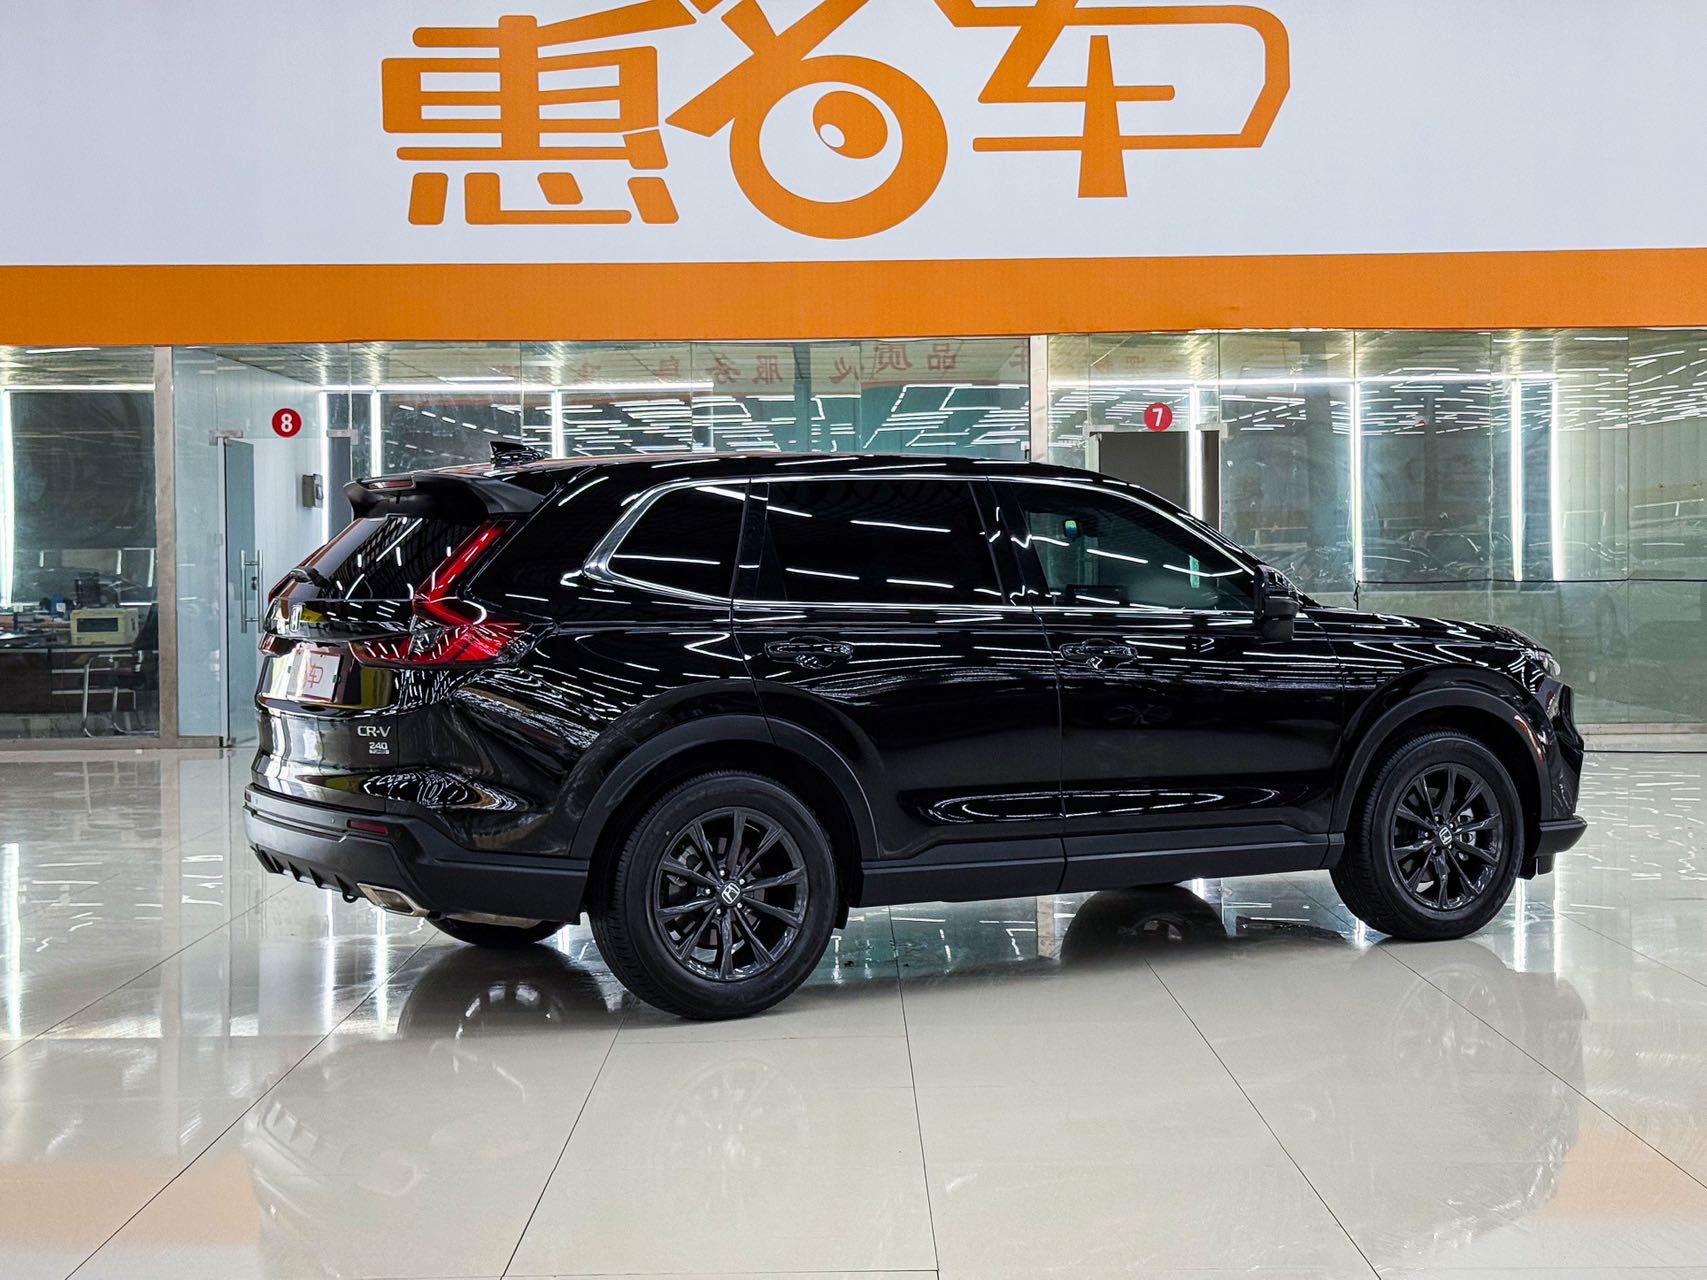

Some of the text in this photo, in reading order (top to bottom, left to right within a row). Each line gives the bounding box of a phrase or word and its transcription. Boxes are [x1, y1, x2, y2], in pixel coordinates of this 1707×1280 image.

[280, 412, 293, 433] 8
[1152, 407, 1164, 427] 7
[356, 725, 392, 738] CR-V
